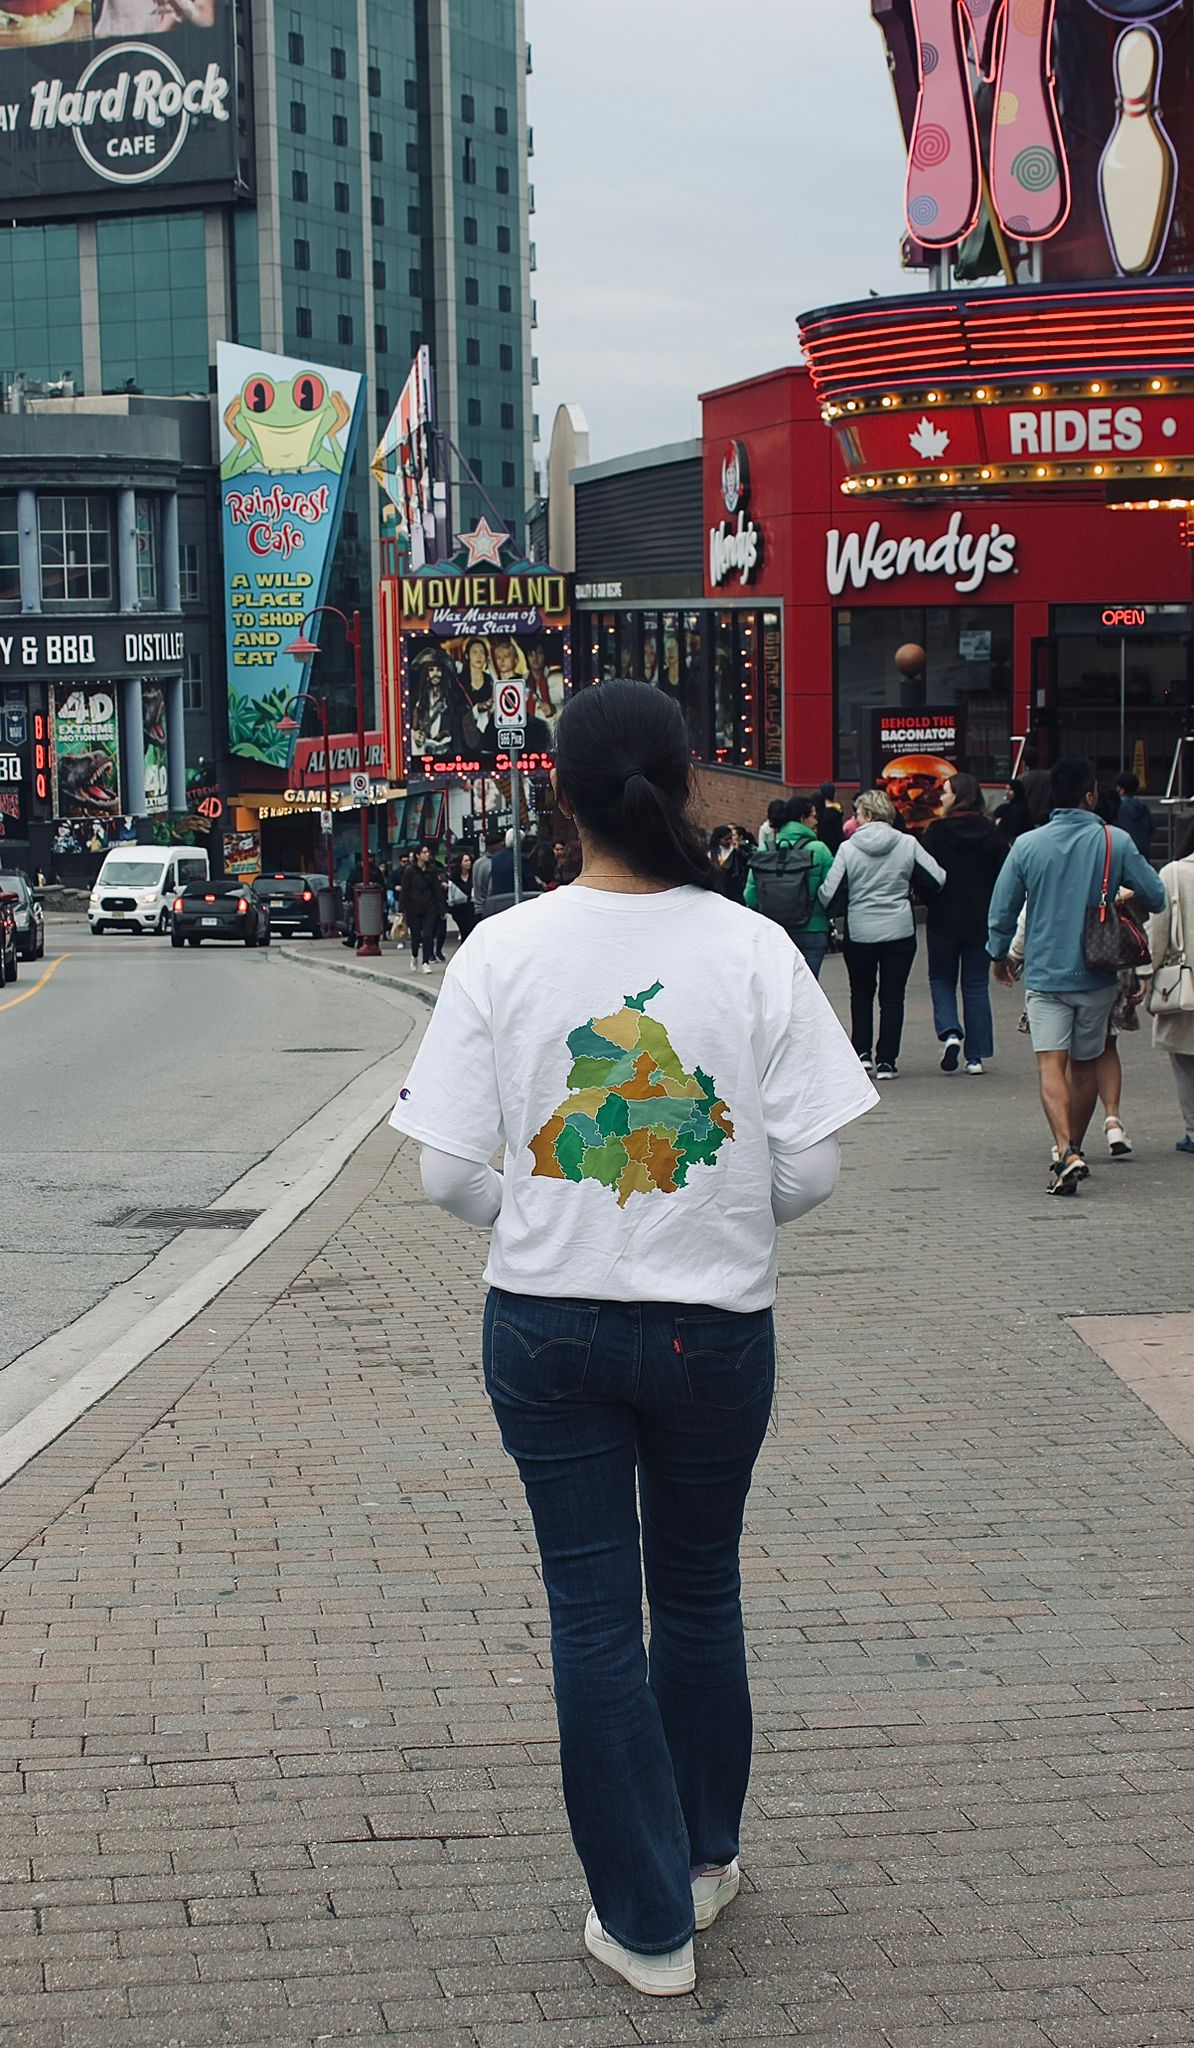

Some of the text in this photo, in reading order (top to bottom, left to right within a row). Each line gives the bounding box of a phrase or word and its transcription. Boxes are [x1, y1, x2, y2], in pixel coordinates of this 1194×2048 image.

[30, 71, 130, 130] Hard
[133, 63, 230, 128] Rock
[106, 135, 156, 158] CAFE
[1009, 406, 1143, 455] RIDES
[225, 483, 329, 525] Rainforest
[247, 519, 305, 560] Cafe
[710, 510, 757, 588] Wendy's
[826, 511, 1016, 595] Wendy's
[231, 572, 313, 588] A WILD
[231, 592, 303, 608] PLACE
[402, 575, 564, 617] MOVIELAND
[232, 612, 305, 627] TO SHOP
[433, 605, 537, 625] Wax Museum of
[1102, 610, 1145, 625] OPEN
[452, 621, 517, 635] The Stars
[233, 632, 281, 646] AND
[22, 636, 39, 665] &
[46, 635, 96, 664] BBQ
[233, 651, 276, 666] EAT
[57, 691, 113, 724] 4D
[59, 723, 114, 734] EXTREME
[881, 716, 955, 729] BEHOLD THE
[59, 734, 96, 742] MOTION
[881, 728, 955, 742] BACONATOR
[198, 797, 223, 819] 4D
